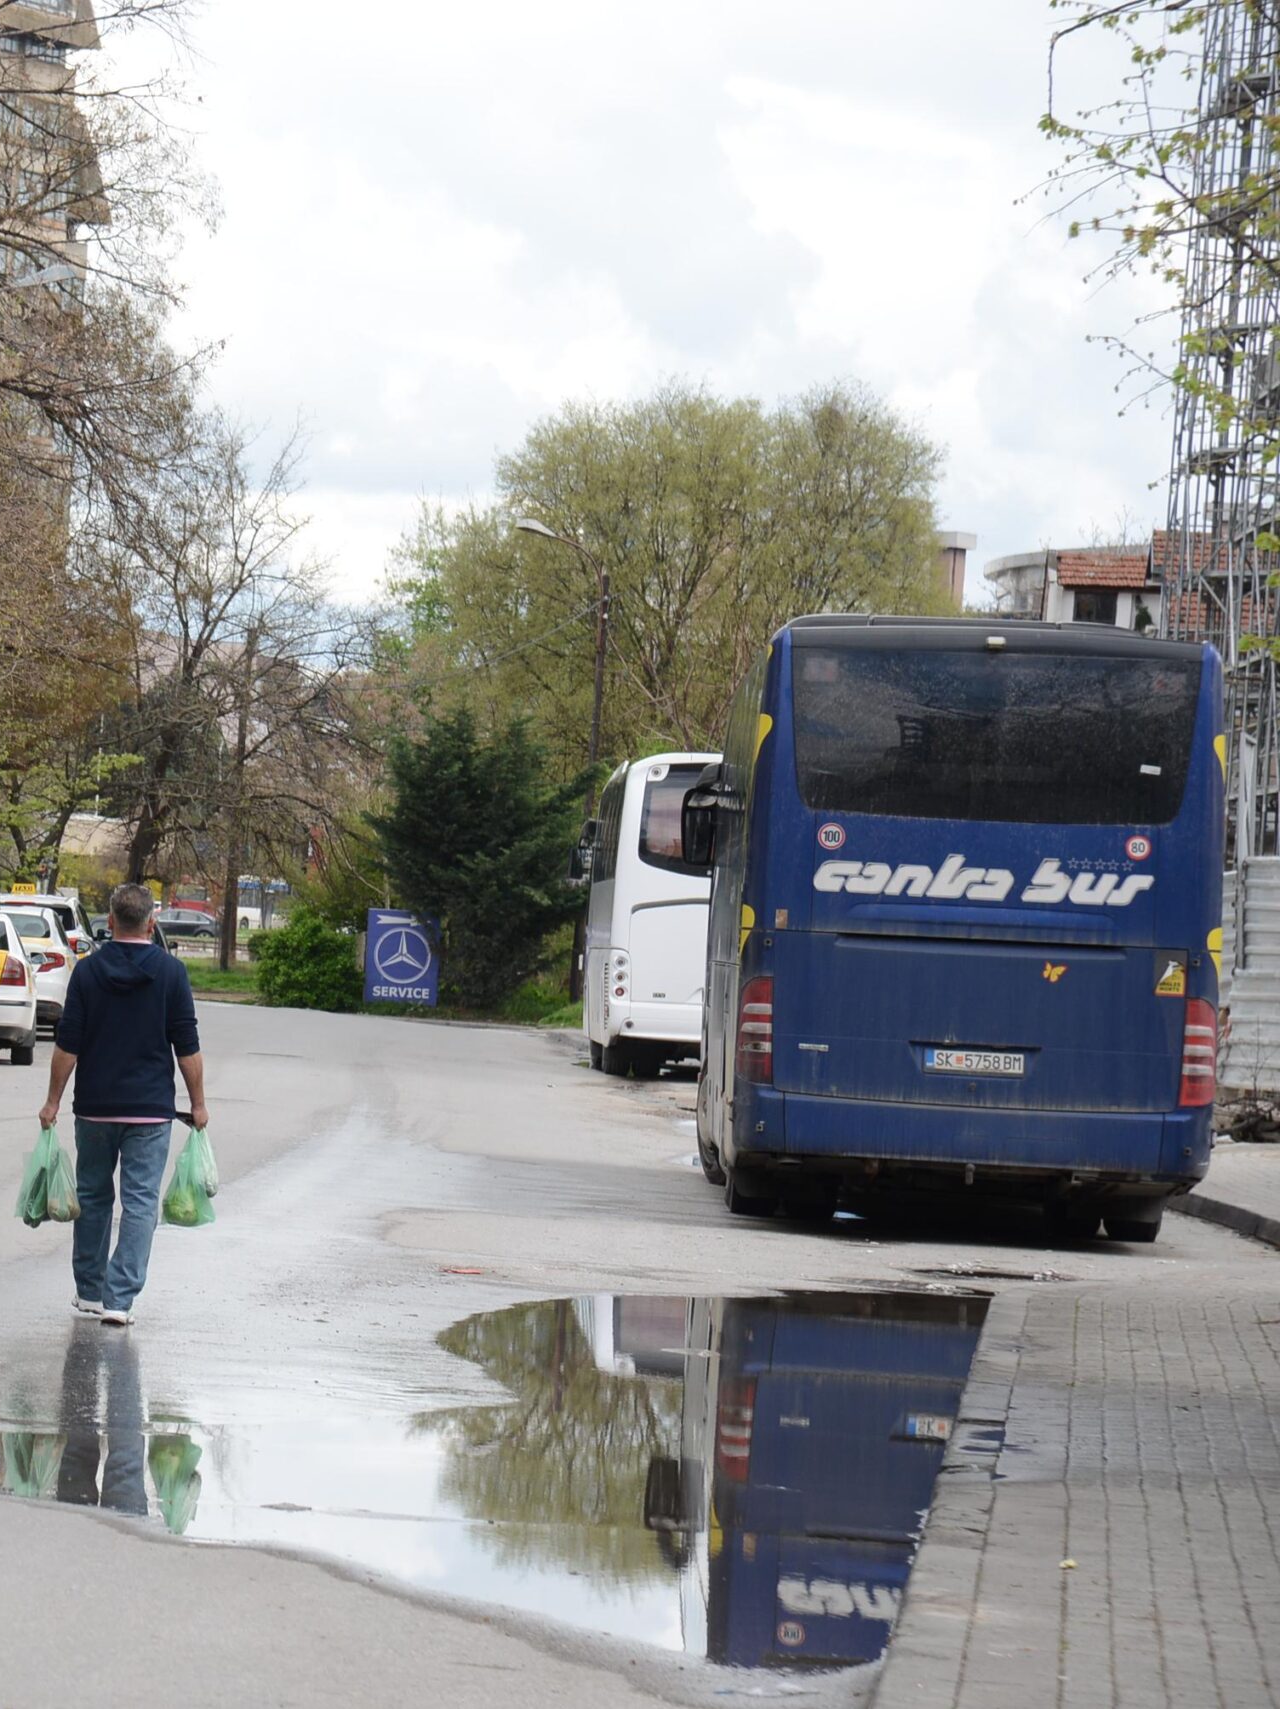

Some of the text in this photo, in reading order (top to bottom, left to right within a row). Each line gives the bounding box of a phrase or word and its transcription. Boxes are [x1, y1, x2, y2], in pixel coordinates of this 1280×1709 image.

[822, 830, 840, 844] 100
[1131, 842, 1146, 854] 80
[1021, 857, 1155, 906] bus
[372, 985, 430, 999] SERVICE
